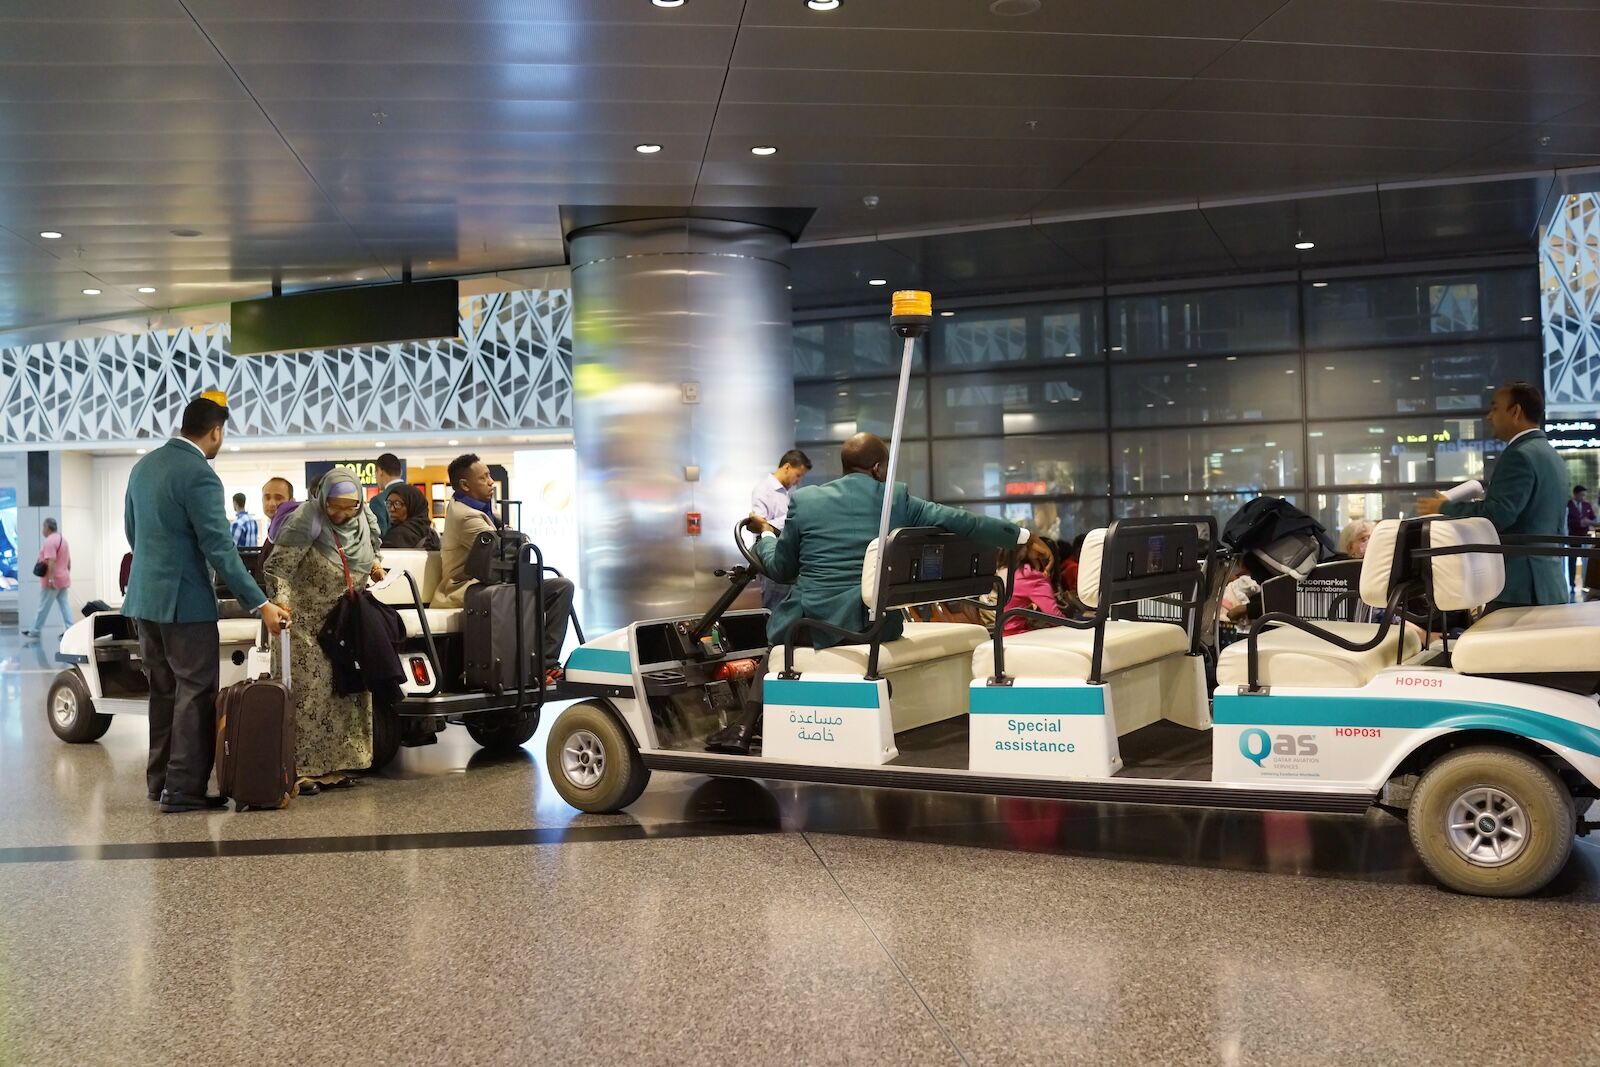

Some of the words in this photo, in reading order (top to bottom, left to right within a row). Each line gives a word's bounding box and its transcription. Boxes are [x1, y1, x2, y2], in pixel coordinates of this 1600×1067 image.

[1395, 677, 1443, 688] HOP031
[789, 710, 843, 725] مساعدة
[1008, 718, 1061, 735] Special
[1335, 727, 1381, 738] HOP031
[798, 727, 835, 742] خاصة
[995, 738, 1075, 753] assistance
